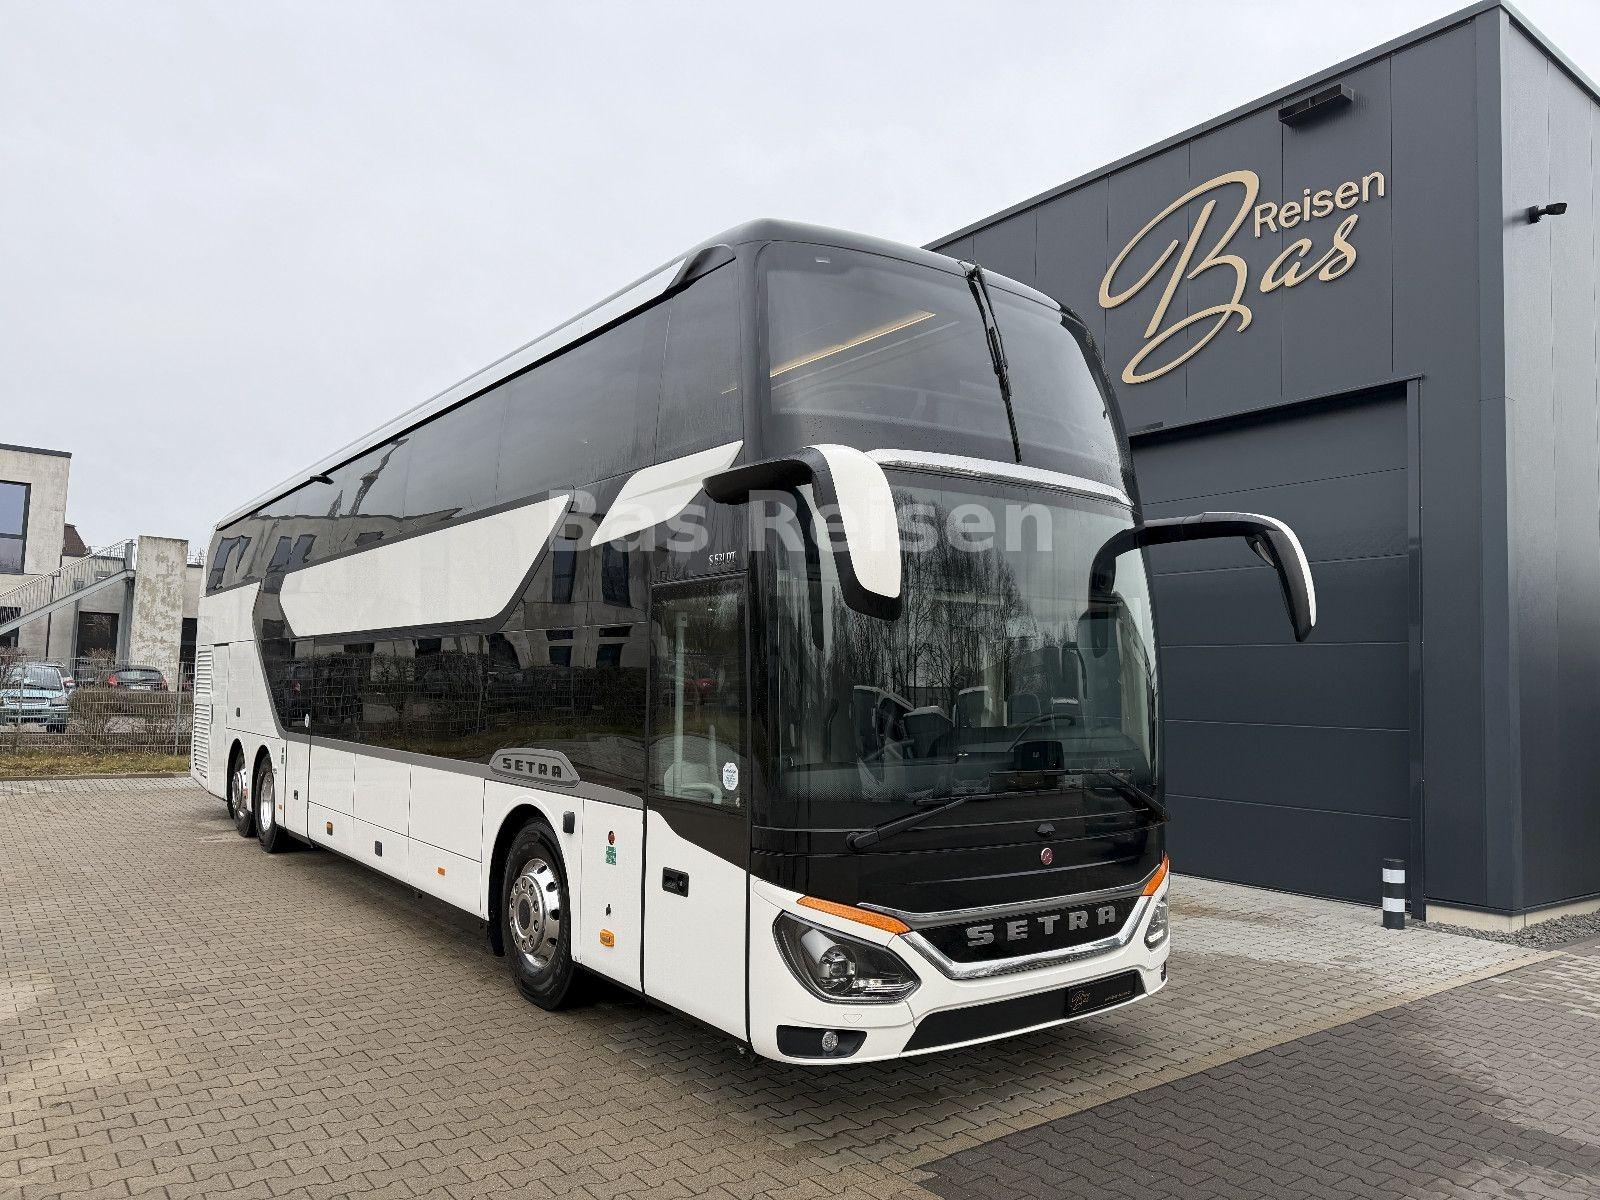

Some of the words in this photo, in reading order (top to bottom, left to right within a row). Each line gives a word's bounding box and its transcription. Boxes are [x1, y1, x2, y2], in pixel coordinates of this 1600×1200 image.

[1254, 170, 1386, 239] Reisen
[1098, 169, 1359, 384] Bas
[502, 757, 562, 778] SETRA
[966, 905, 1116, 947] SETRA
